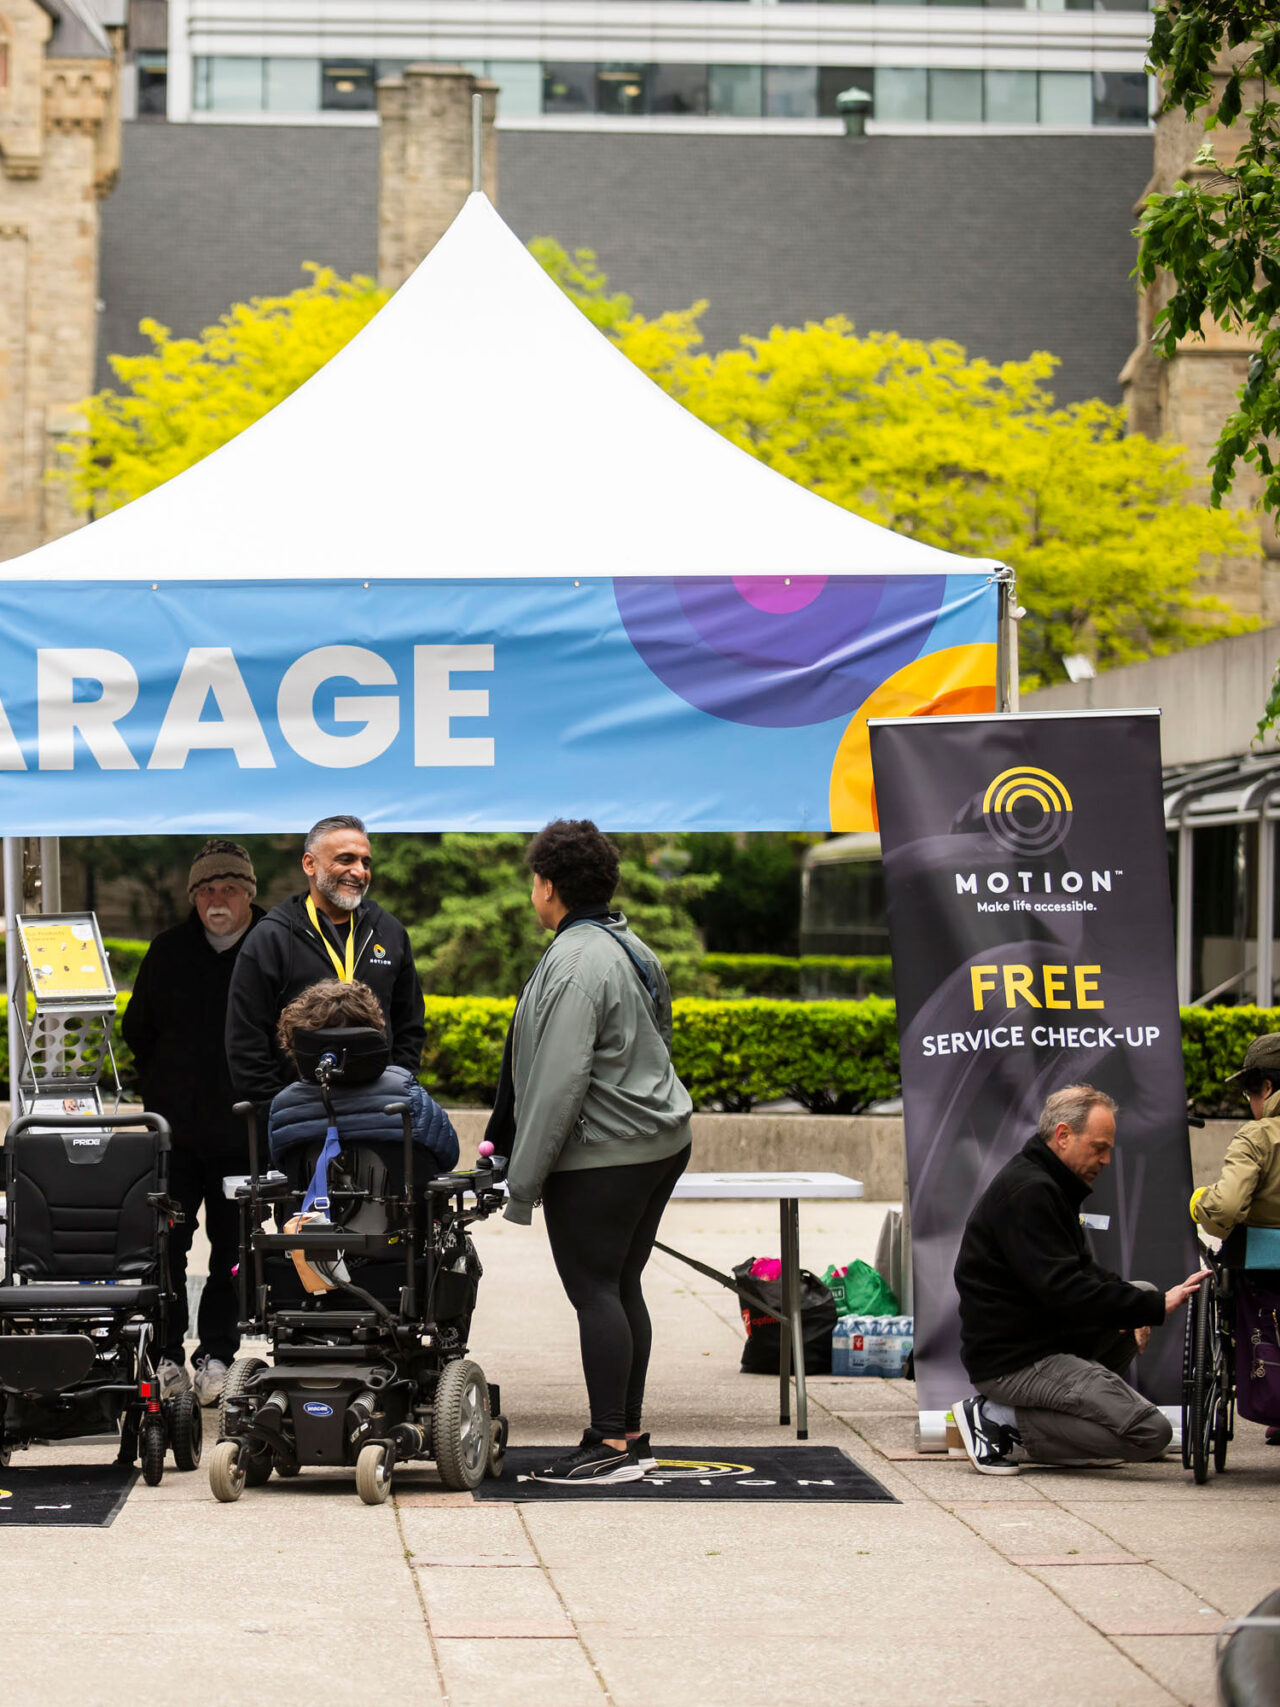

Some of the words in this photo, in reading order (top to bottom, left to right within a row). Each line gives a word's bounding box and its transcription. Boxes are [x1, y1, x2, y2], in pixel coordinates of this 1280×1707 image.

[977, 901, 1010, 913] Make
[1013, 900, 1032, 911] life
[1034, 900, 1097, 912] accessible.
[970, 964, 1105, 1011] FREE
[922, 1026, 1025, 1057] SERVICE
[1031, 1025, 1161, 1049] CHECK-UP
[72, 1138, 101, 1146] PRIDE
